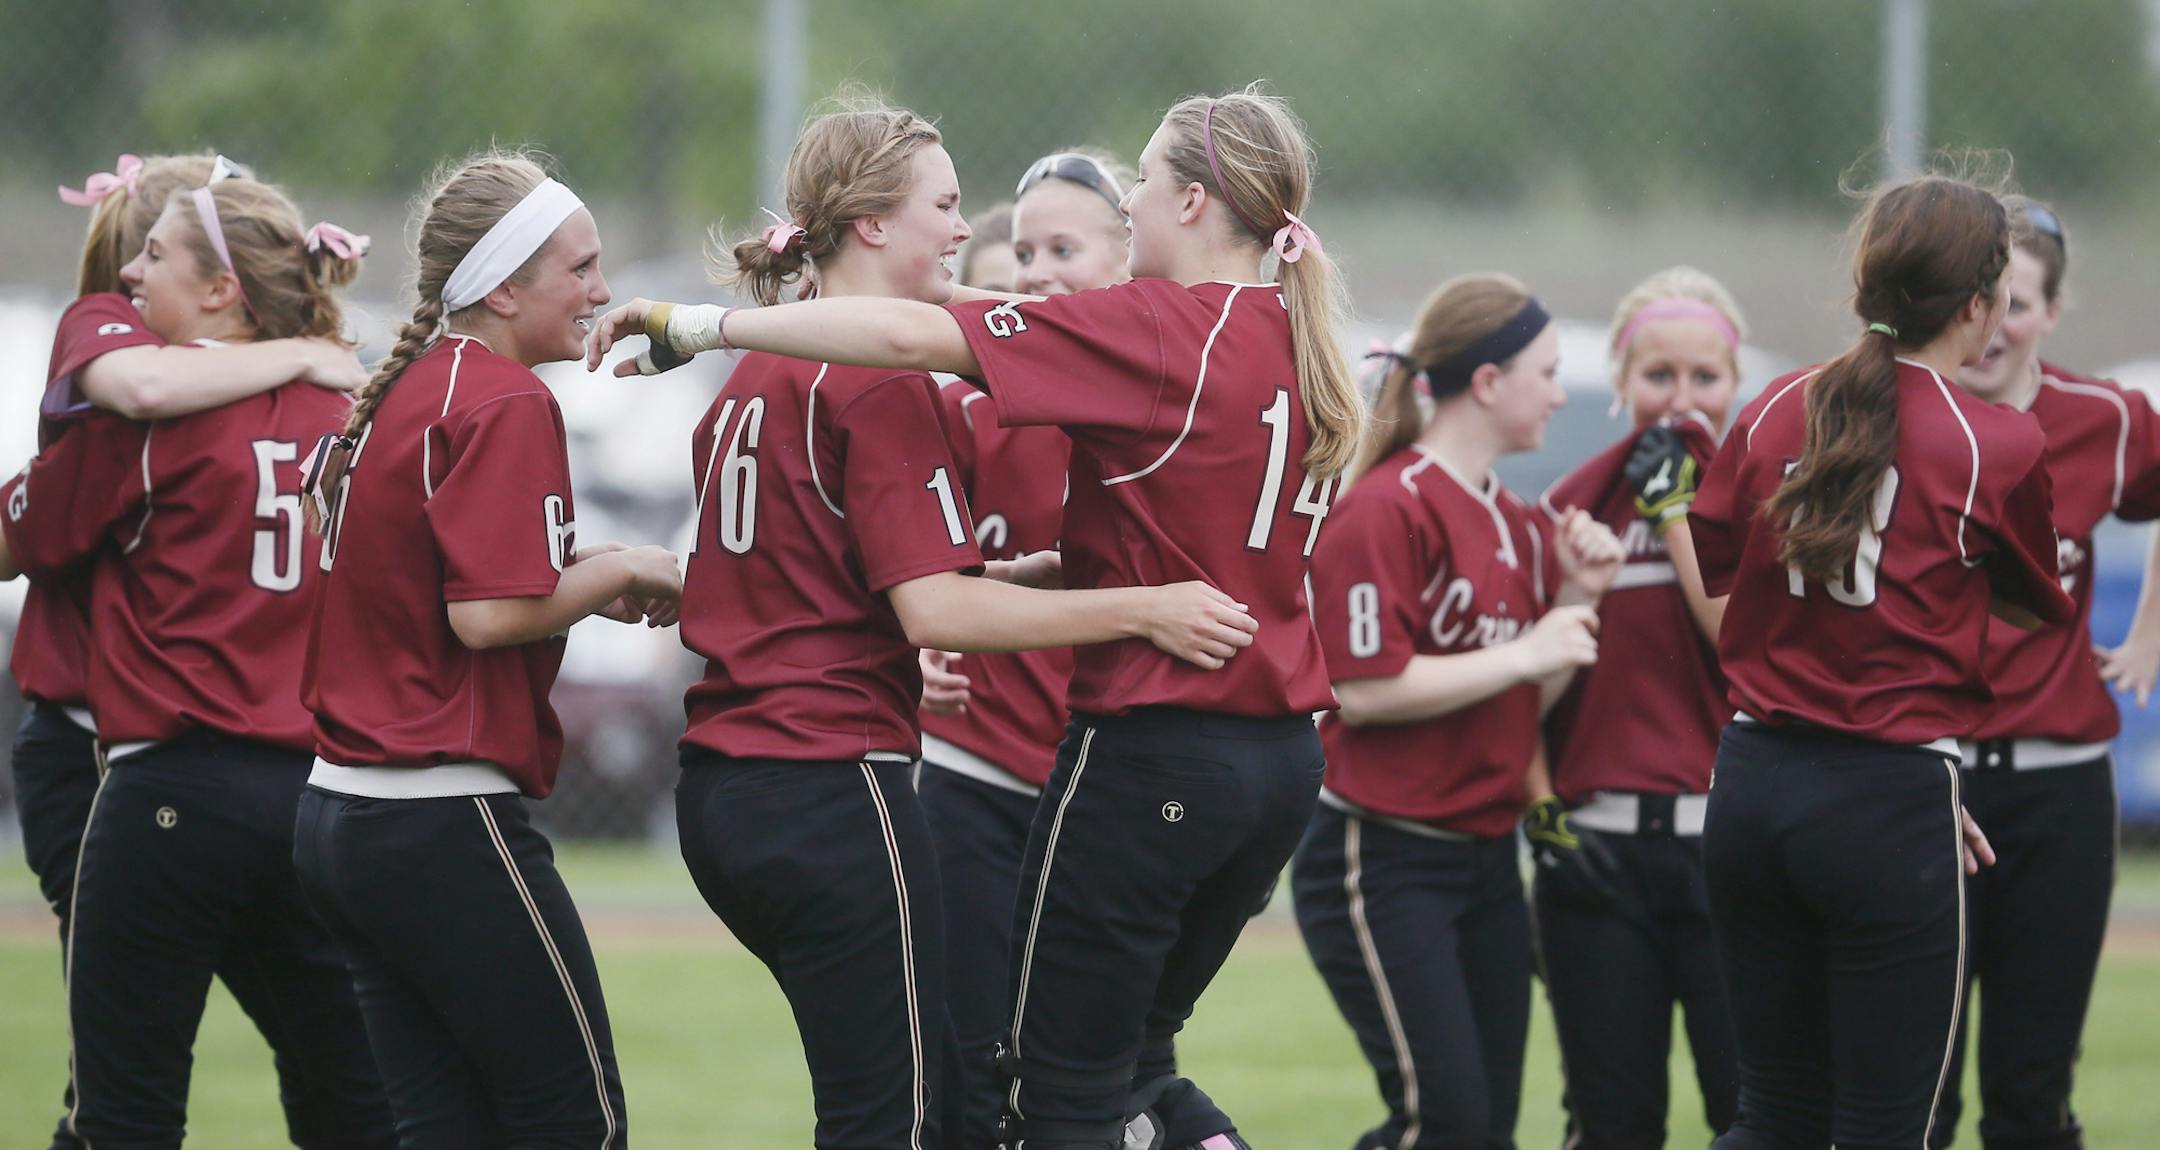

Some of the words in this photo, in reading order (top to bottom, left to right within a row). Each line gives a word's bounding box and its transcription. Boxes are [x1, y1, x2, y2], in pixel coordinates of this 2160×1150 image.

[983, 301, 1028, 337] G
[688, 396, 765, 554] 16
[926, 467, 976, 546] 1
[1247, 389, 1330, 556] 14
[252, 440, 304, 592] 5
[544, 495, 565, 573] 6
[1347, 582, 1381, 658] 8
